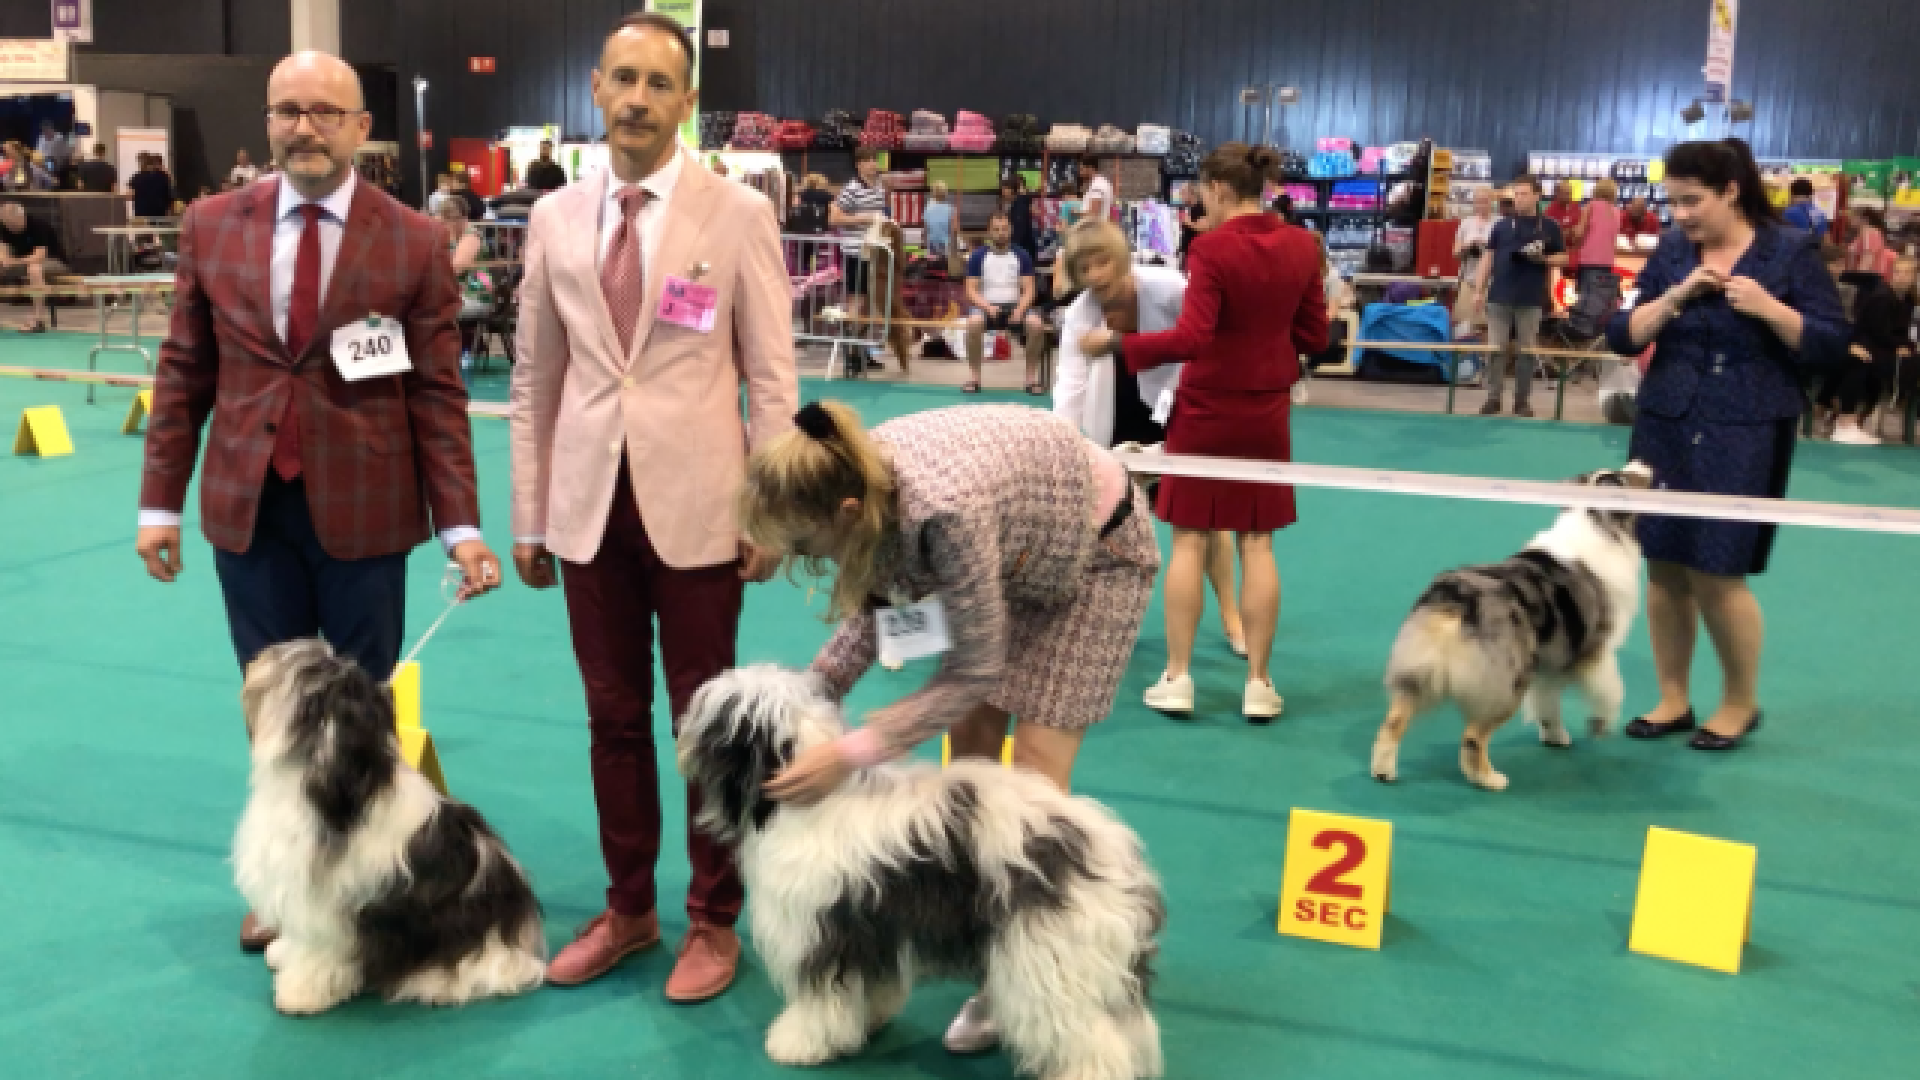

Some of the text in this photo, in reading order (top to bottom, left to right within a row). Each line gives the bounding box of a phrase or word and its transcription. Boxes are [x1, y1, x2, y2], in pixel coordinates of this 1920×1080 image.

[347, 333, 393, 363] 240
[1304, 827, 1368, 900] 2
[1293, 897, 1369, 932] SEC
